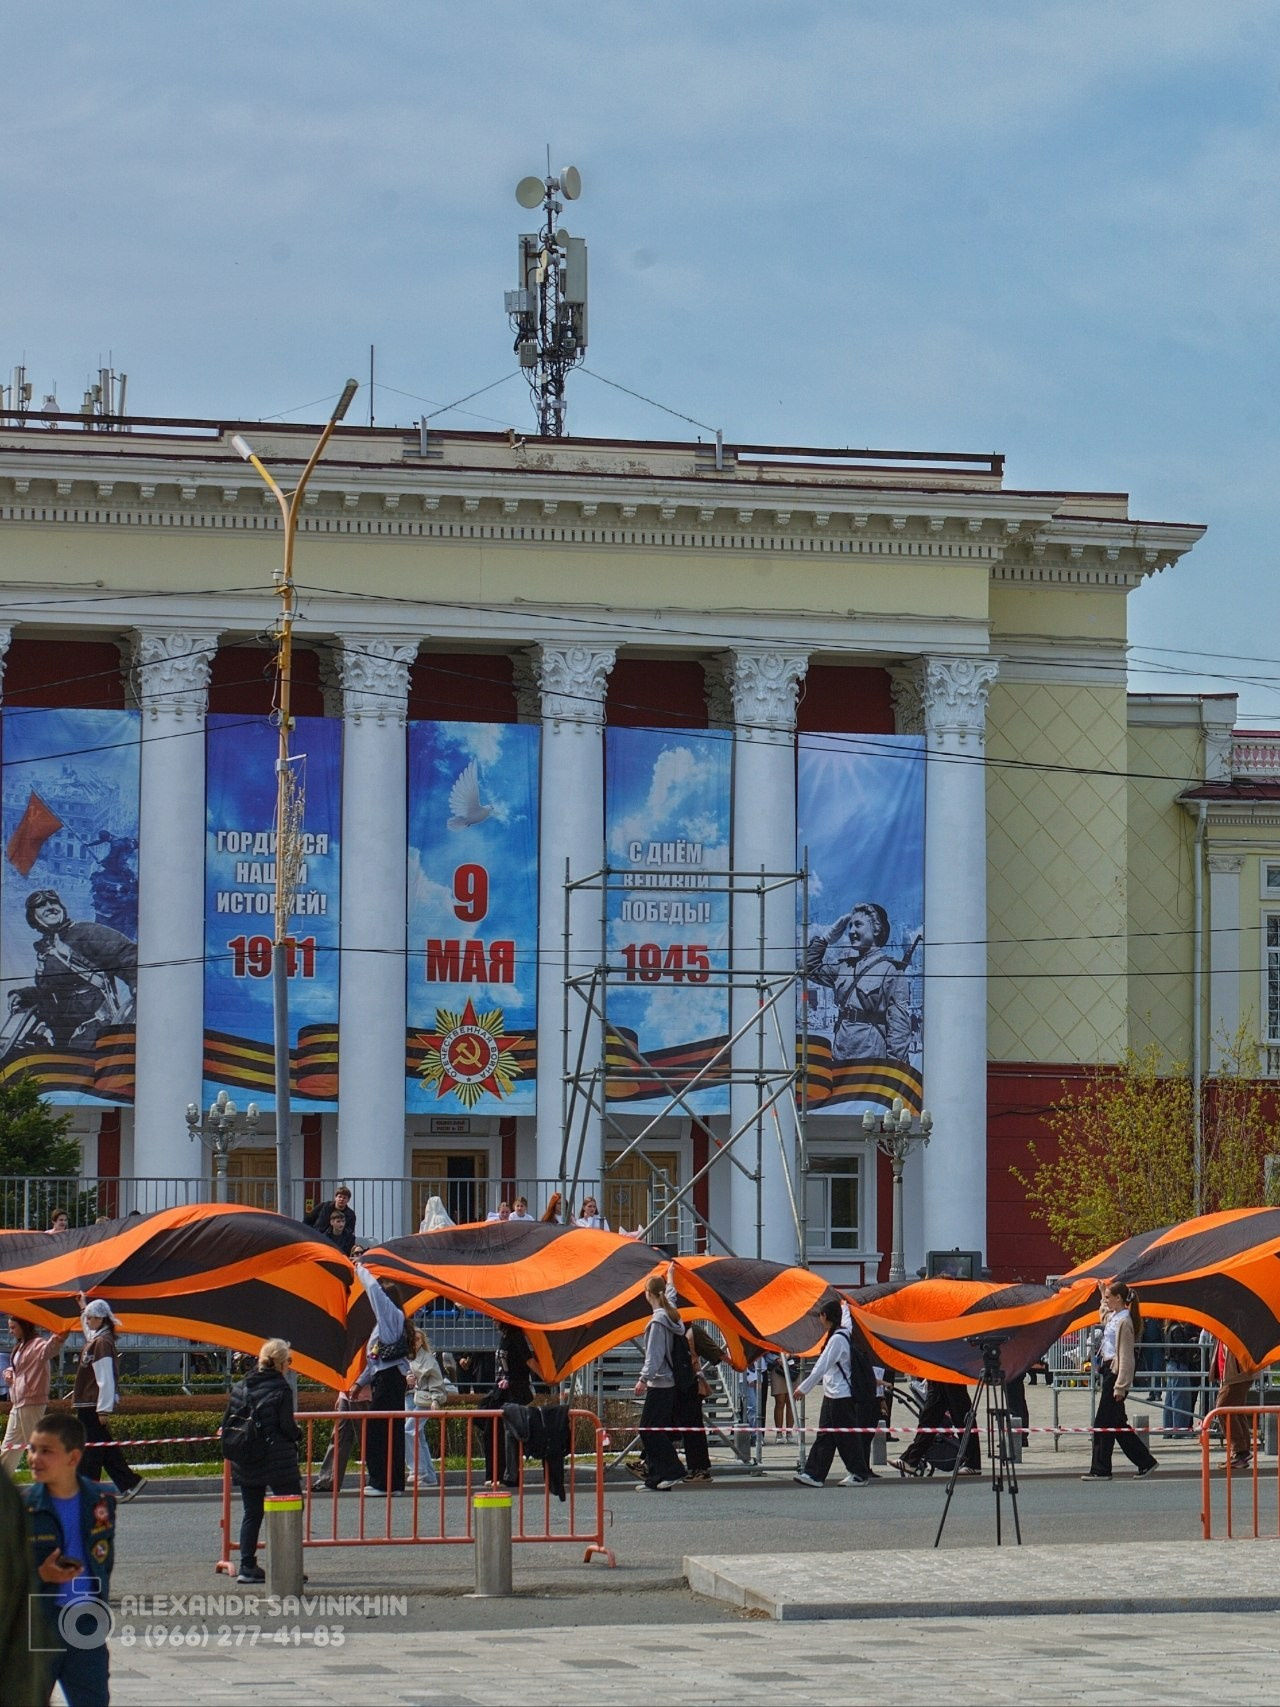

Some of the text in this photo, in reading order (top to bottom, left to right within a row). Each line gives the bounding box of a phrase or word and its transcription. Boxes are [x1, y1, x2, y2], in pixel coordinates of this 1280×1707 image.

[217, 831, 328, 856] ГОРДИСЯ
[629, 840, 702, 866] С ДНЁМ
[236, 862, 307, 884] НАШЙ
[454, 863, 489, 922] 9
[622, 901, 711, 925] ПОБЕДЫ!
[426, 939, 516, 984] МАЯ
[621, 943, 710, 983] 1945
[441, 1026, 492, 1078] ОТЕЧЕСТВЕННАЯ
